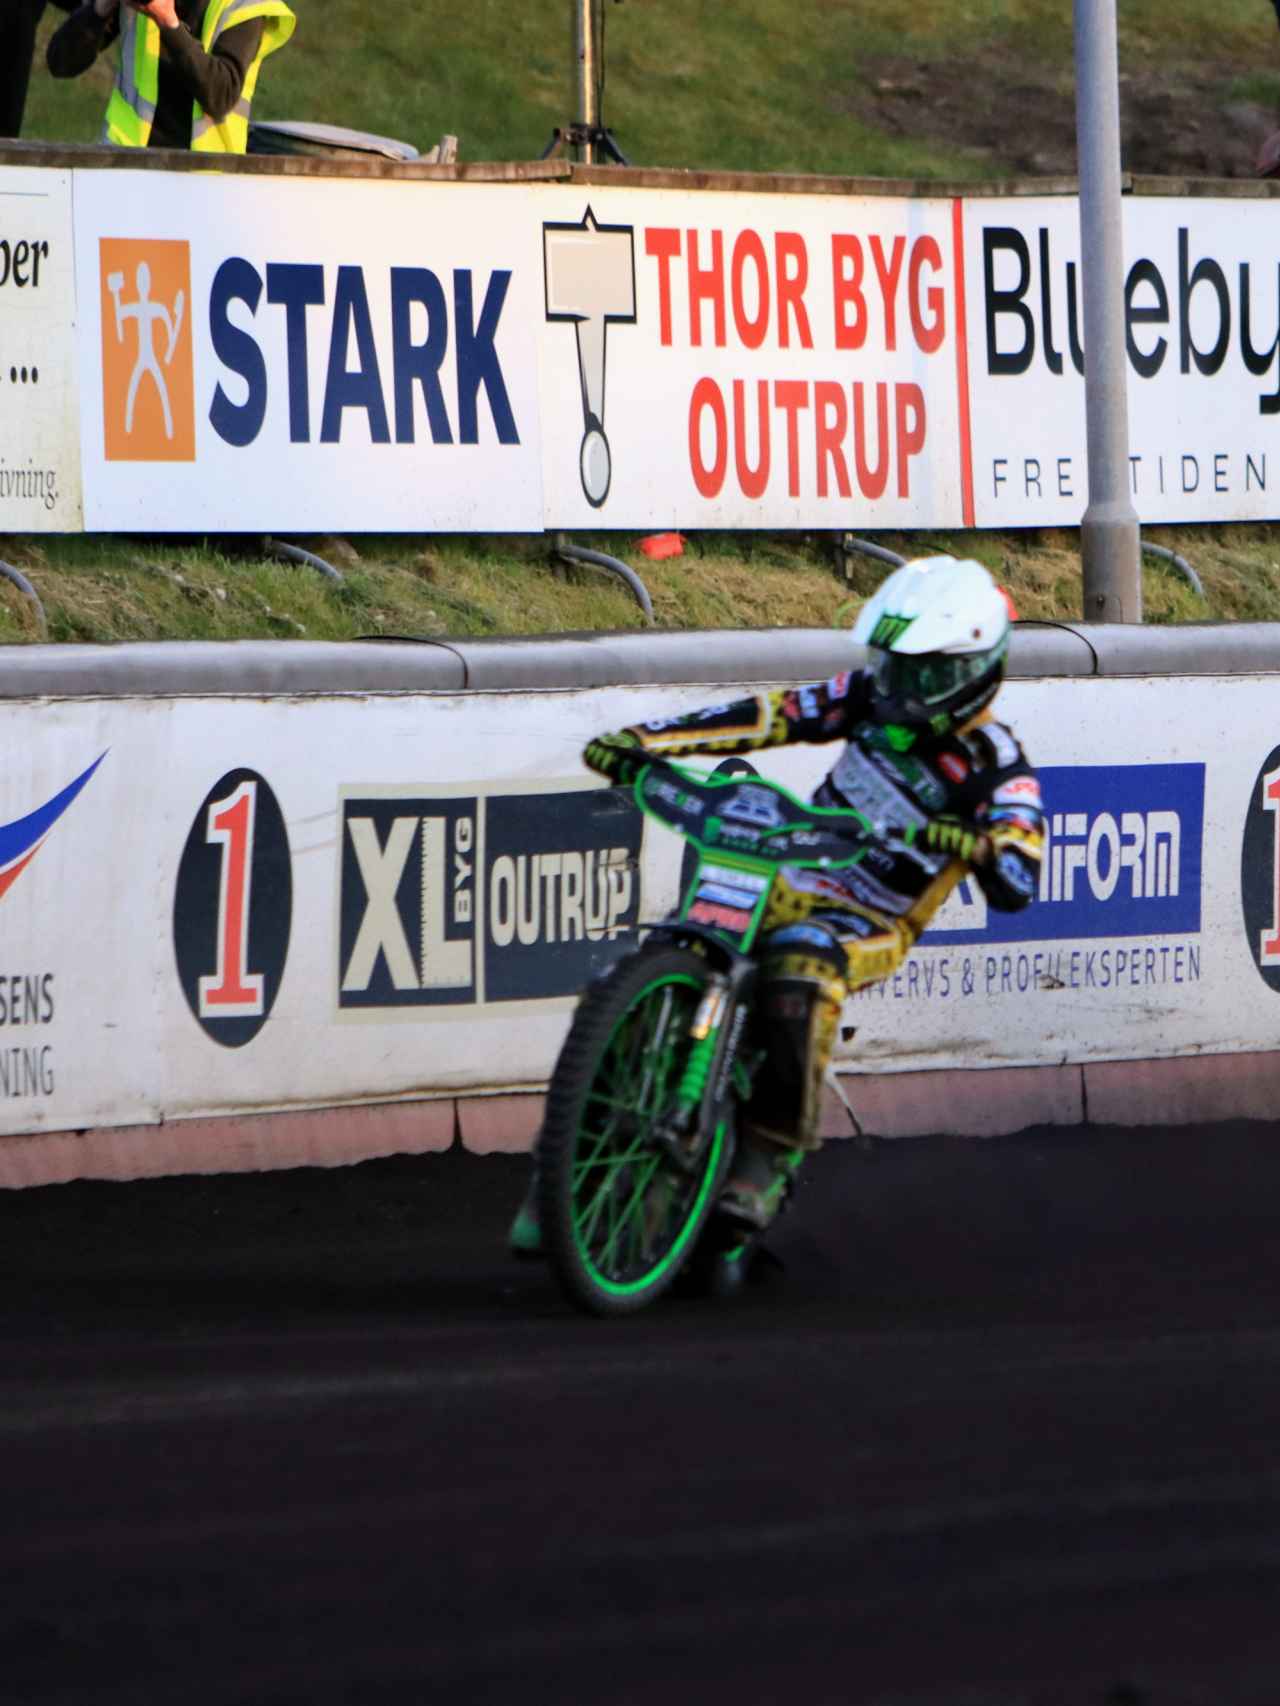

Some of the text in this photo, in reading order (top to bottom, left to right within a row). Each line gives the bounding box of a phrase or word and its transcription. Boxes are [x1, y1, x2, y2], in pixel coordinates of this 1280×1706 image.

[208, 256, 521, 448] STARK
[644, 227, 946, 354] THOR BYG
[687, 376, 927, 500] OUTRUP
[341, 816, 473, 992] XL
[454, 816, 473, 923] BYG
[490, 847, 632, 948] OUTRUP
[961, 957, 975, 995] &
